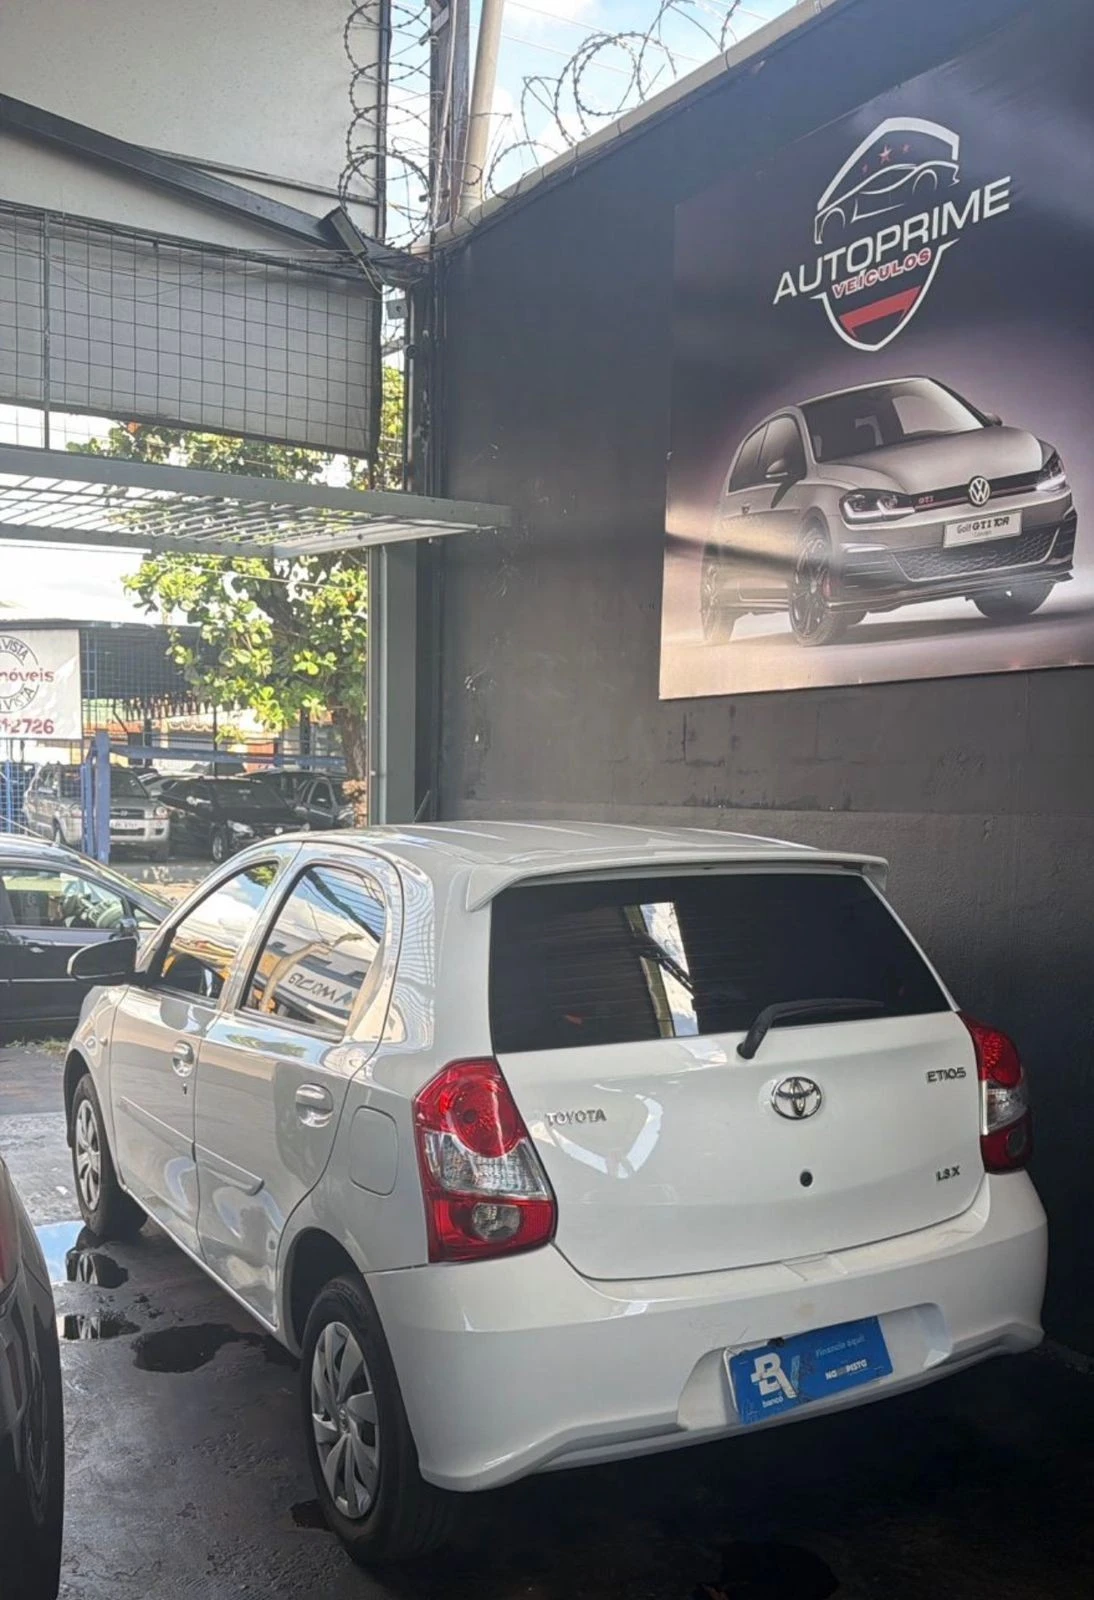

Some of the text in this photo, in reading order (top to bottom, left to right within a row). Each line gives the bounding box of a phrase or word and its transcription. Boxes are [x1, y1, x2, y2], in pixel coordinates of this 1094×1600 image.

[773, 176, 1011, 304] AUTOPRIME
[832, 247, 932, 299] VEÍCULOS
[926, 1067, 967, 1082] ETIOS
[545, 1109, 608, 1127] TOYOTA
